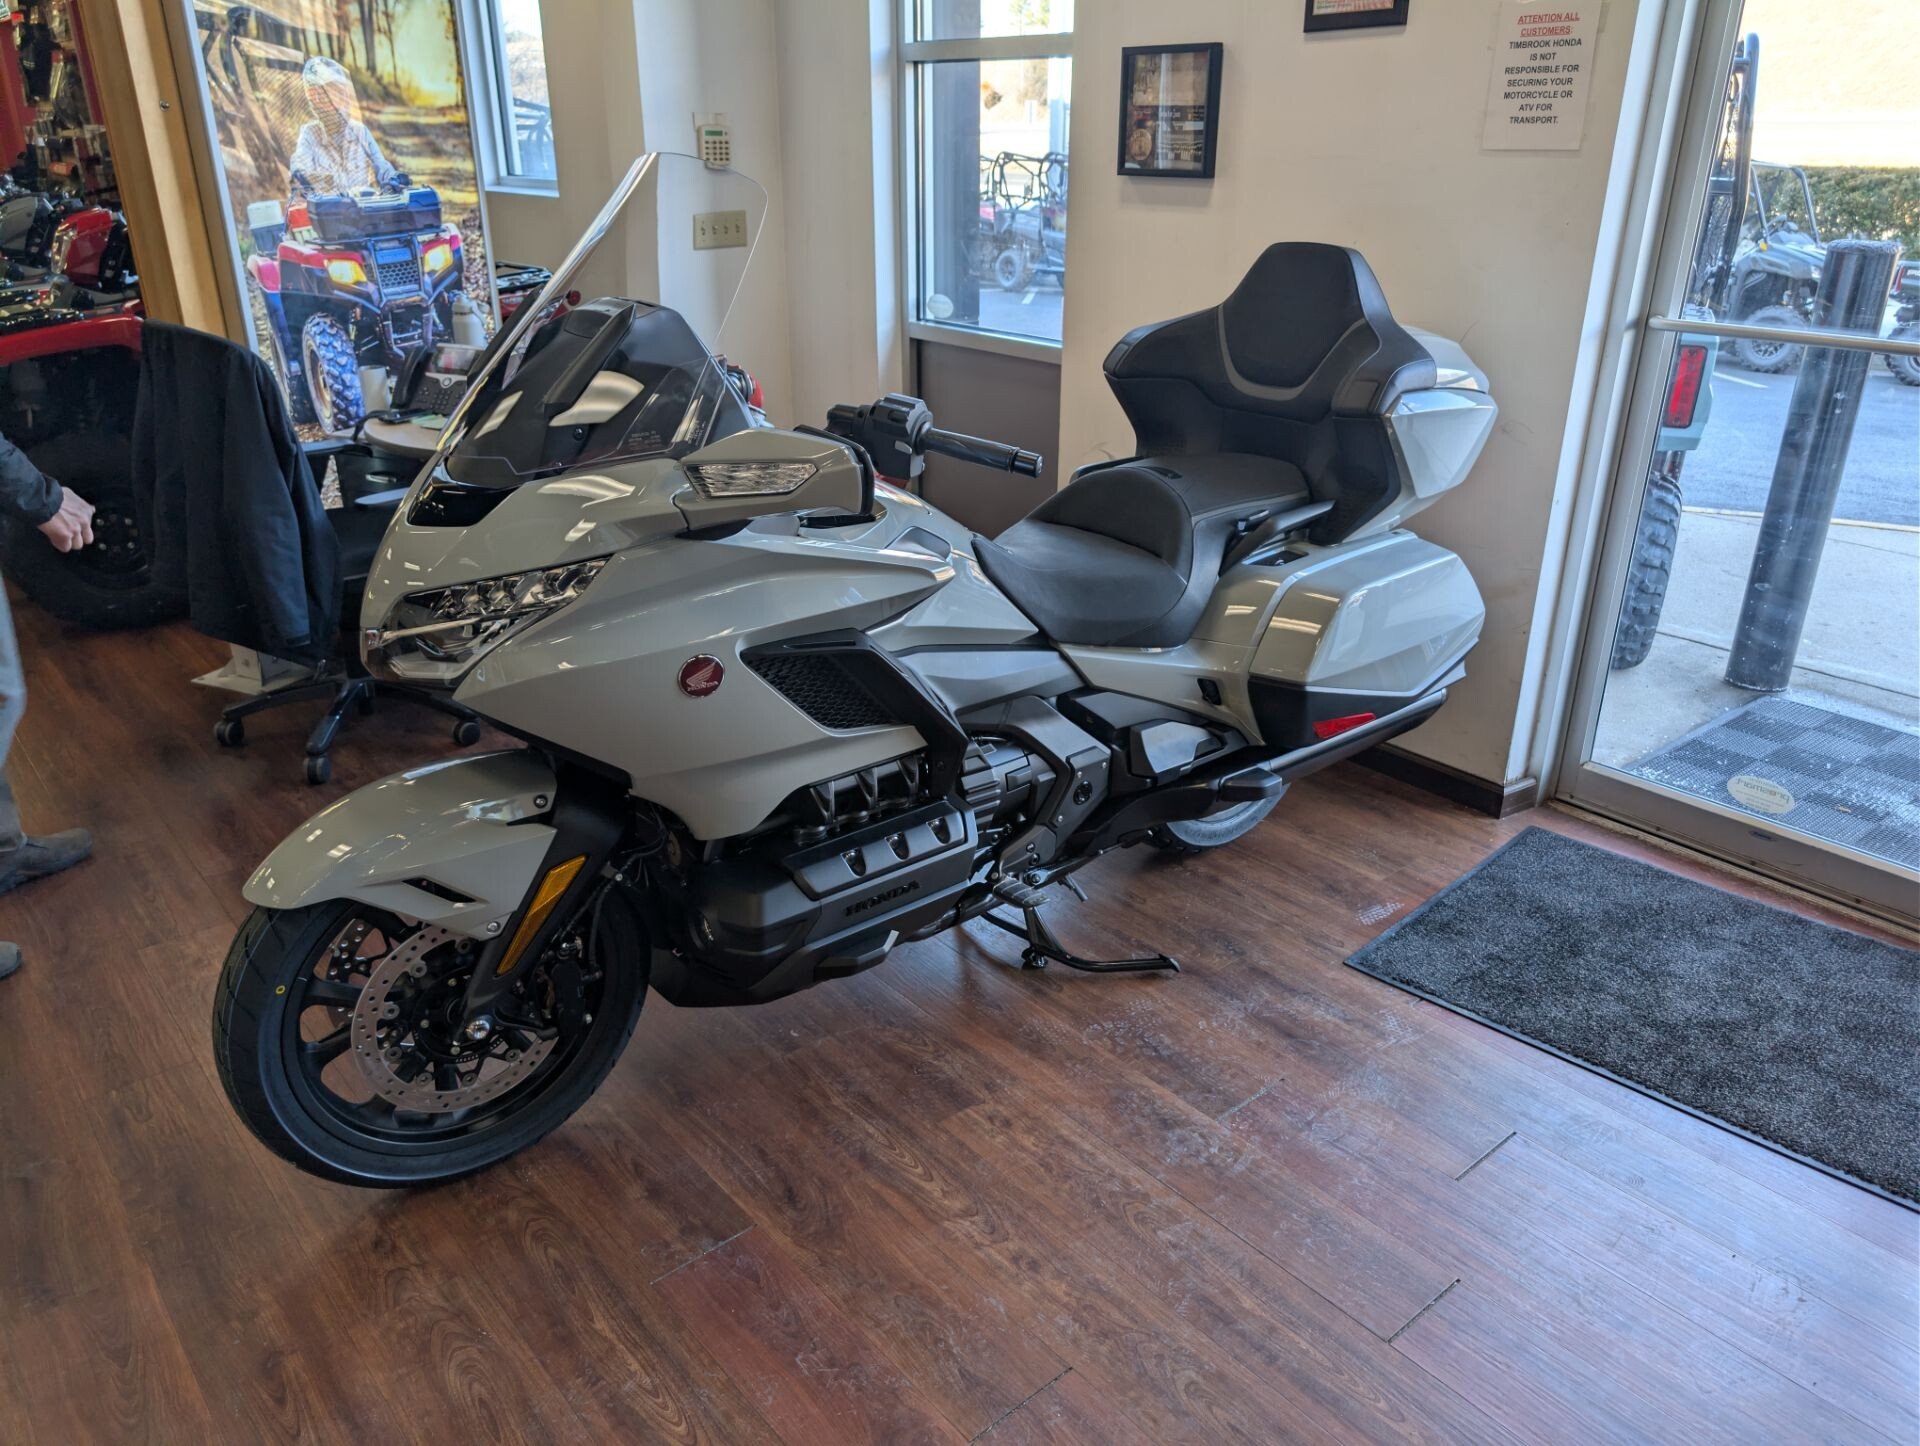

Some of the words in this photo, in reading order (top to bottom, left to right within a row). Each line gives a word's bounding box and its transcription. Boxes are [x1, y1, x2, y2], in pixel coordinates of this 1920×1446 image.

[1518, 13, 1562, 24] ATTENTION
[1563, 12, 1580, 21] ALL
[1520, 26, 1573, 37] CUSTOMERS:
[1509, 40, 1550, 49] TIMBROOK
[1552, 38, 1582, 47] HONDA
[1530, 53, 1537, 61] IS
[1540, 52, 1557, 61] NOT
[1505, 65, 1560, 75] RESPONSIBLE
[1562, 64, 1579, 73] FOR
[1507, 79, 1547, 87] SECURING
[1550, 77, 1573, 86] YOUR
[1504, 91, 1558, 99] MOTORCYCLE
[1560, 90, 1573, 98] OR
[1536, 103, 1552, 111] FOR
[1510, 116, 1559, 124] TRANSPORT.
[844, 880, 920, 917] HONDA
